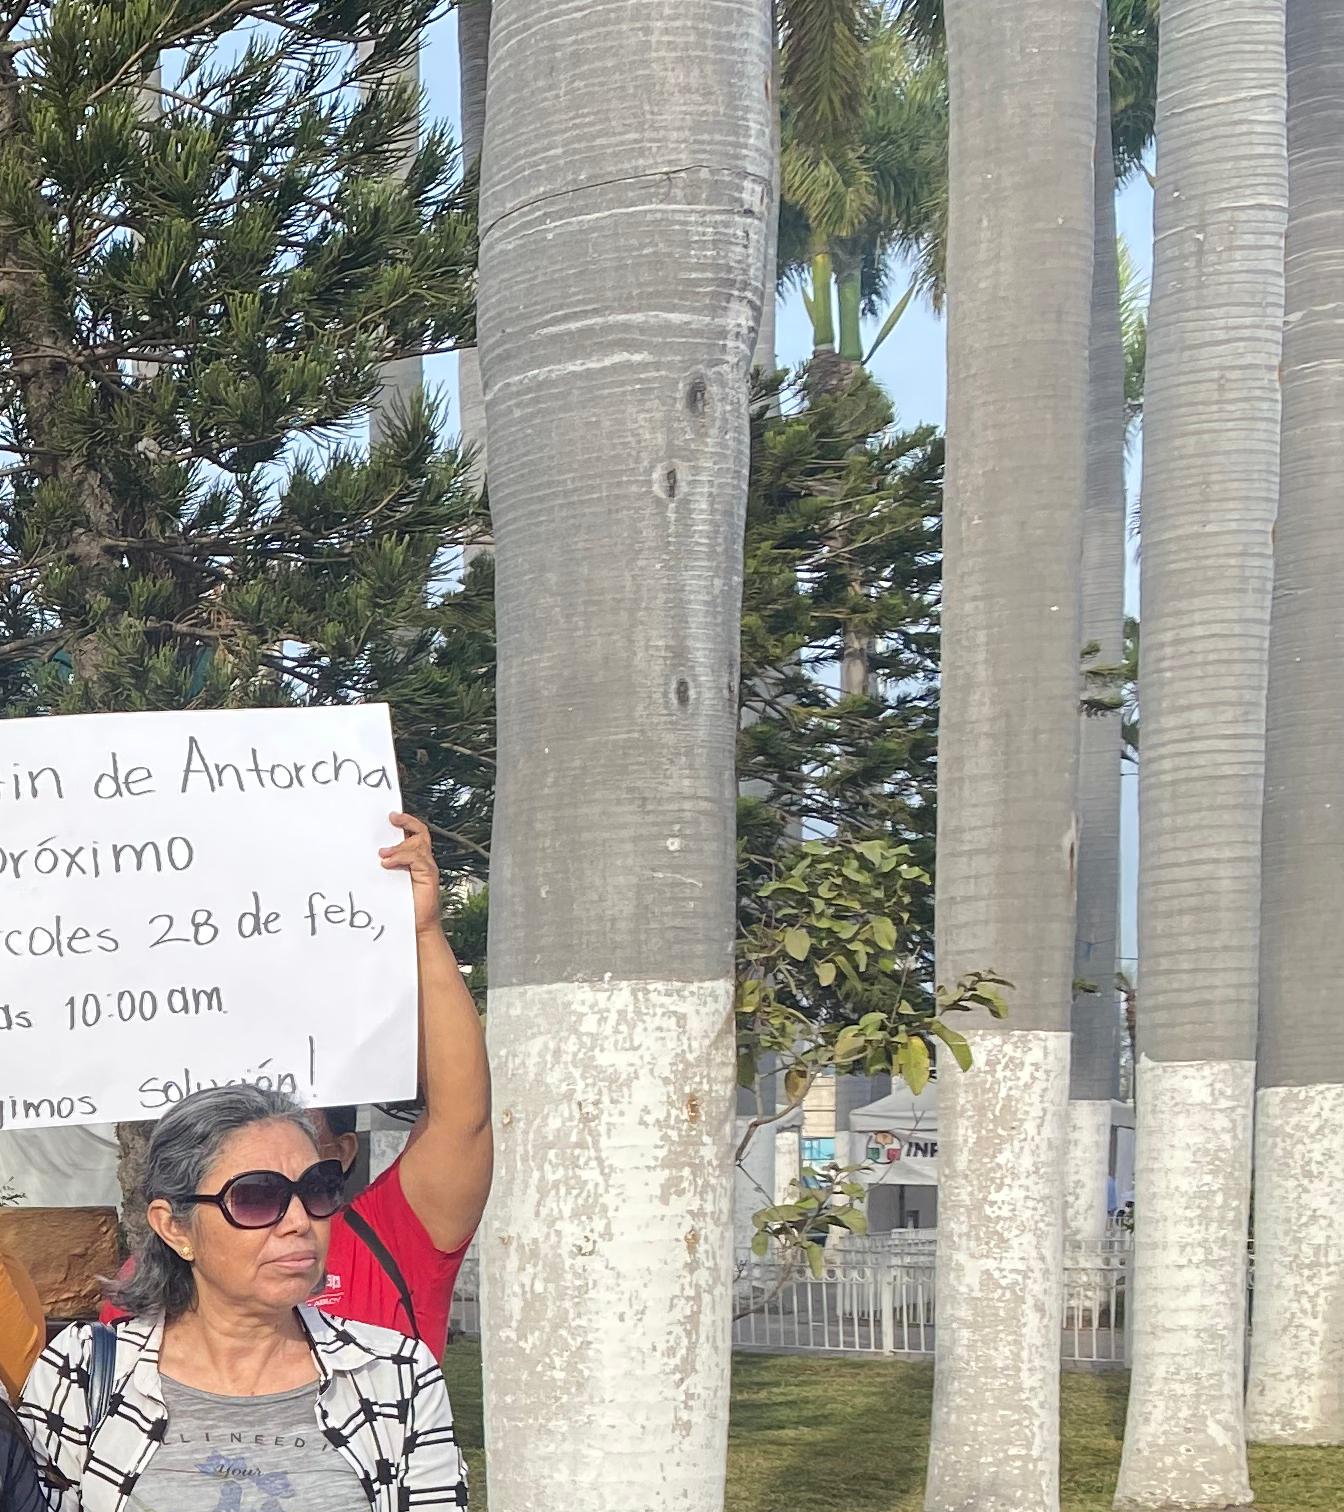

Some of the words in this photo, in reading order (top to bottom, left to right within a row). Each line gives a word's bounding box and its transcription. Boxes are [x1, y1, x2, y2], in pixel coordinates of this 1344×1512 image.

[93, 751, 157, 800] de
[180, 735, 393, 794] Antorcha
[148, 908, 220, 949] 28
[238, 892, 282, 939] de
[64, 987, 158, 1031] 10:00
[162, 1433, 190, 1446] LL
[230, 1432, 306, 1448] NEED
[216, 1462, 263, 1478] Your
